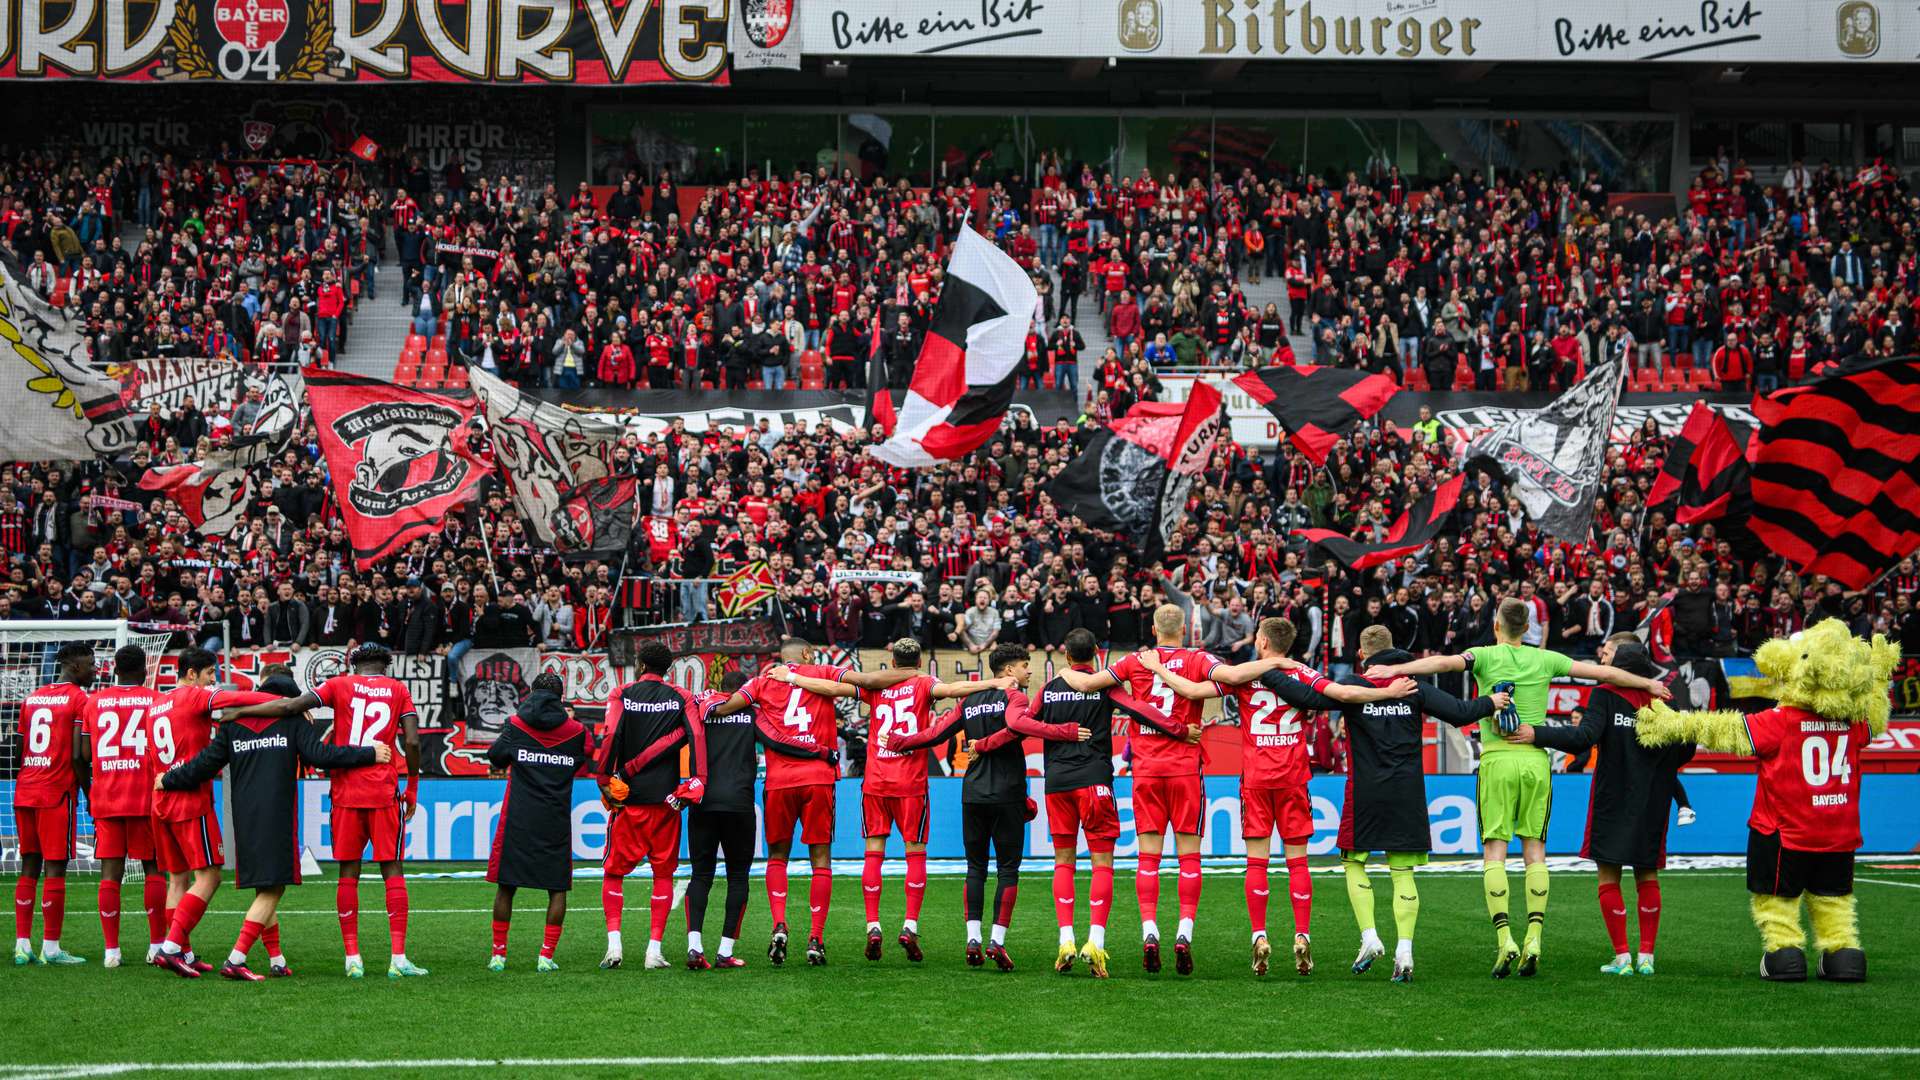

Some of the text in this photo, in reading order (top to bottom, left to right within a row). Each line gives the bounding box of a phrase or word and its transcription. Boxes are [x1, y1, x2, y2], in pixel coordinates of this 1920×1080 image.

[217, 7, 286, 21] BAYER
[832, 11, 908, 49] Bitte
[918, 11, 975, 35] ein
[1199, 0, 1482, 57] Bitburger
[1555, 0, 1762, 56] Bitte ein Bit
[218, 41, 280, 81] 04
[331, 0, 729, 80] KURVE
[83, 117, 190, 145] WIR FÜR
[408, 120, 505, 147] IHR FÜR
[97, 696, 153, 708] FOSU-MENSAH
[623, 697, 680, 712] Barmenia
[783, 687, 812, 733] 4
[1148, 671, 1175, 718] 5
[1249, 690, 1303, 736] 22
[30, 708, 52, 753] 6
[97, 709, 148, 757] 24
[153, 716, 175, 764] 9
[232, 733, 288, 753] Barmenia
[348, 698, 391, 747] 12
[875, 696, 918, 749] 25
[1801, 721, 1826, 732] BRIAN
[517, 749, 575, 766] Barmenia
[1801, 734, 1852, 786] 04
